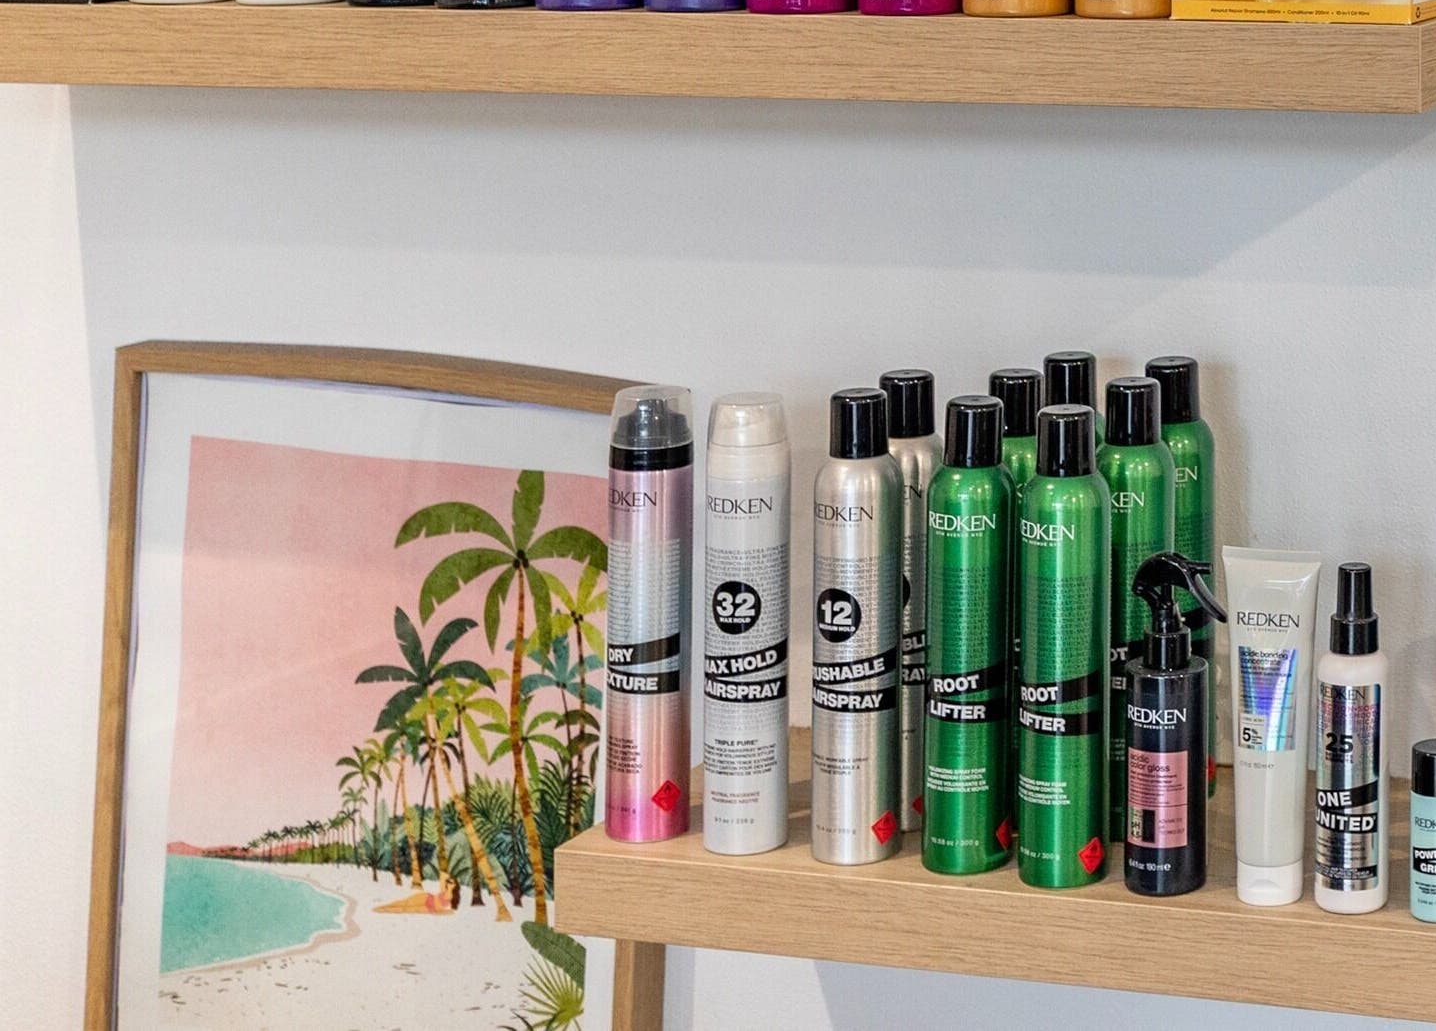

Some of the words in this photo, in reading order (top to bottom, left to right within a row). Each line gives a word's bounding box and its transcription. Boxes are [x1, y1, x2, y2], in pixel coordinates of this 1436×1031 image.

[610, 488, 658, 508] DKEN
[706, 496, 774, 515] REDKEN
[815, 503, 874, 522] EDKEN
[929, 511, 997, 532] REDKEN
[1020, 520, 1076, 541] EDKEN
[716, 591, 756, 616] 32
[821, 601, 852, 625] 12
[1236, 610, 1300, 629] REDKEN
[608, 647, 634, 663] DRY
[732, 650, 777, 672] HOLD
[1258, 651, 1289, 661] bonding
[815, 657, 886, 682] USHABLE
[607, 674, 659, 691] XTURE
[705, 681, 781, 699] AIRSPRAY
[933, 674, 980, 693] ROOT
[813, 688, 884, 709] IRSPRAY
[1020, 686, 1059, 702] ROOT
[929, 699, 987, 720] LIFTER
[1127, 703, 1187, 725] REDKEN
[1019, 708, 1067, 733] LIFTER
[1325, 732, 1354, 754] 25
[1317, 790, 1352, 807] ONE
